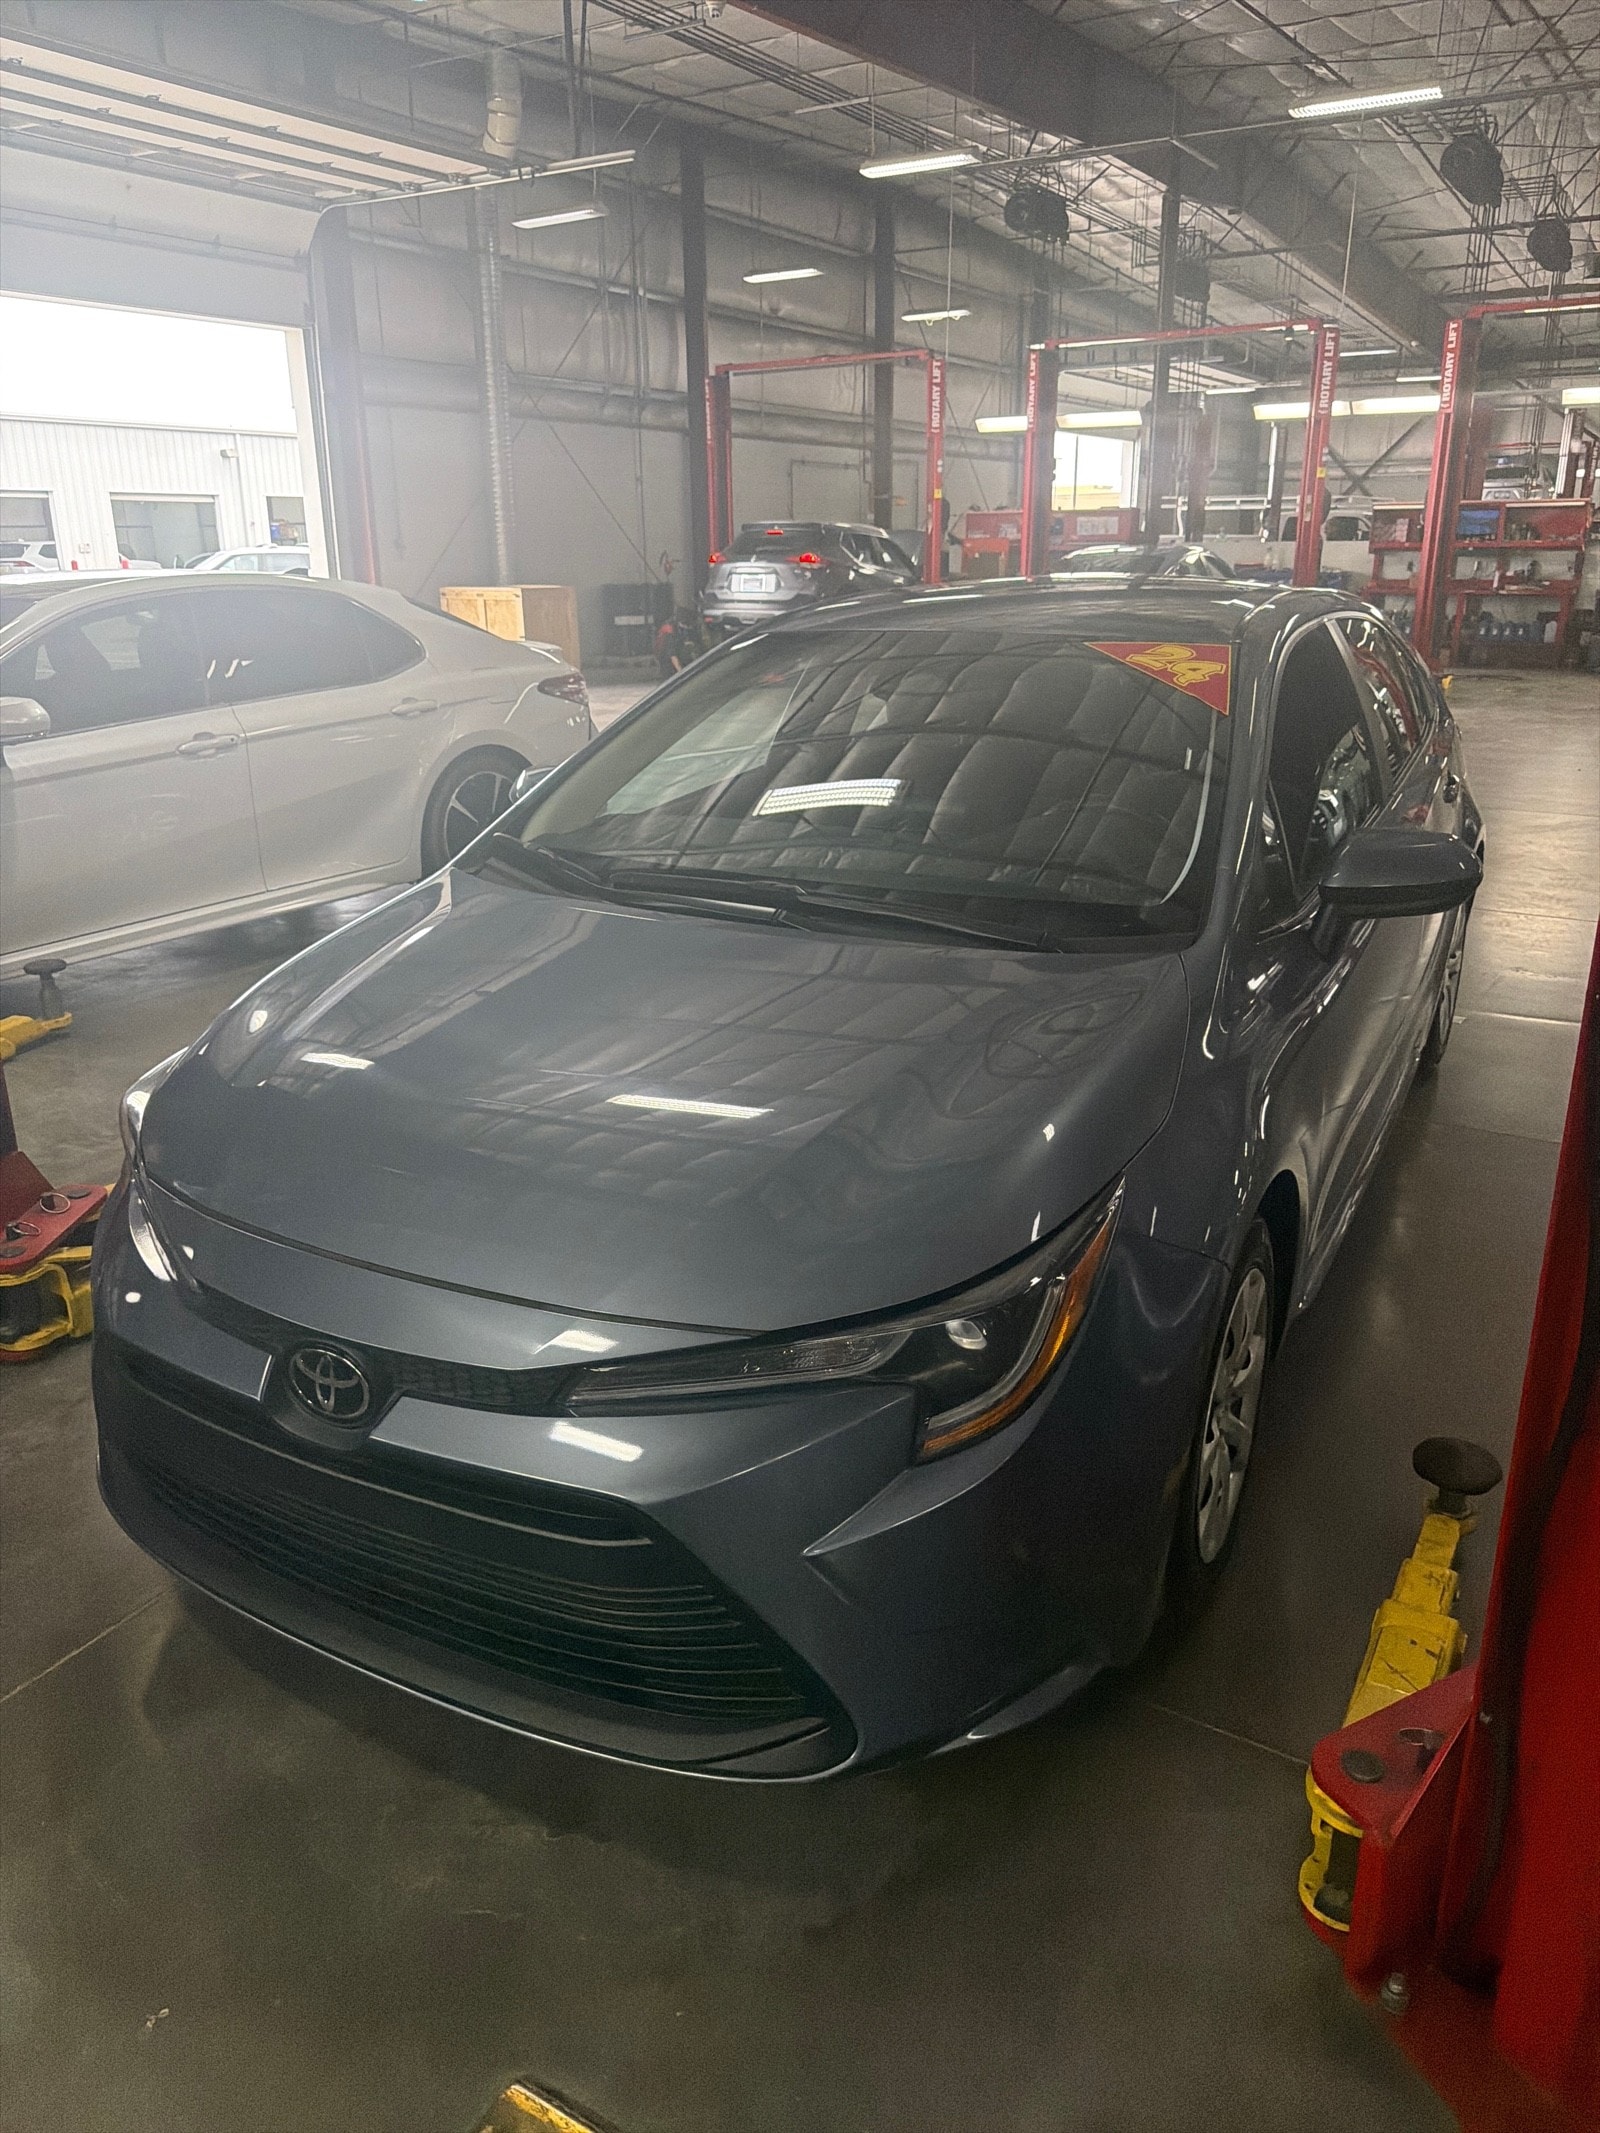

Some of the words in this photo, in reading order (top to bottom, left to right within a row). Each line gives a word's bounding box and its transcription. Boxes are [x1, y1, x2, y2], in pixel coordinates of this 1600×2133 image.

[1324, 331, 1337, 358] LIFT
[1447, 322, 1459, 349] LIFT
[932, 360, 942, 383] LIFT
[1029, 353, 1037, 376] LIFT
[1320, 361, 1334, 408] ROTARY
[1442, 352, 1454, 402] ROTARY
[932, 386, 941, 428] ROTARY
[1027, 379, 1036, 422] ROTARY
[1126, 644, 1226, 687] 24
